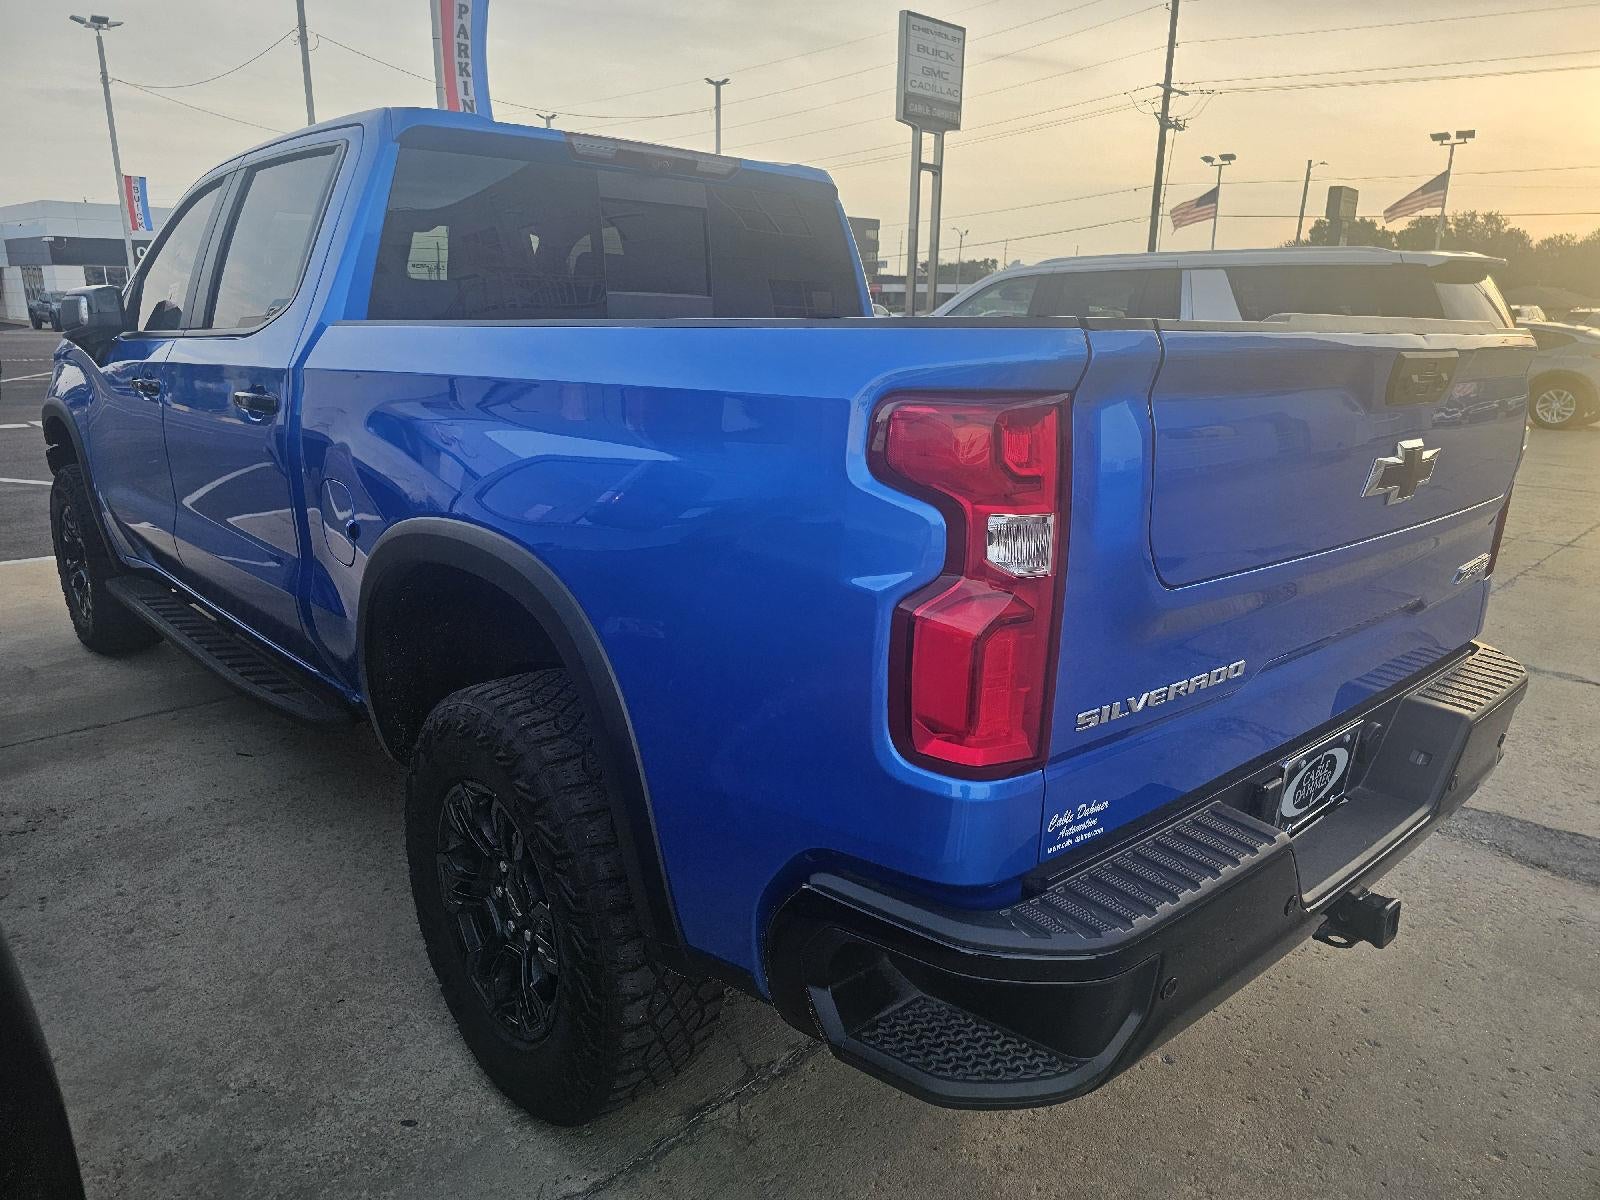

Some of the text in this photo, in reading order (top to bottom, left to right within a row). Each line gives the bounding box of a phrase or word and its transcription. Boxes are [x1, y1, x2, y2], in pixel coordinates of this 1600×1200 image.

[911, 24, 961, 44] CHEVROLET
[456, 3, 475, 113] PARKIN
[916, 43, 956, 62] BUICK
[921, 65, 950, 81] GMC
[909, 79, 960, 98] CADILLAC
[132, 186, 146, 230] BUICK
[1074, 659, 1247, 732] SILVERADO
